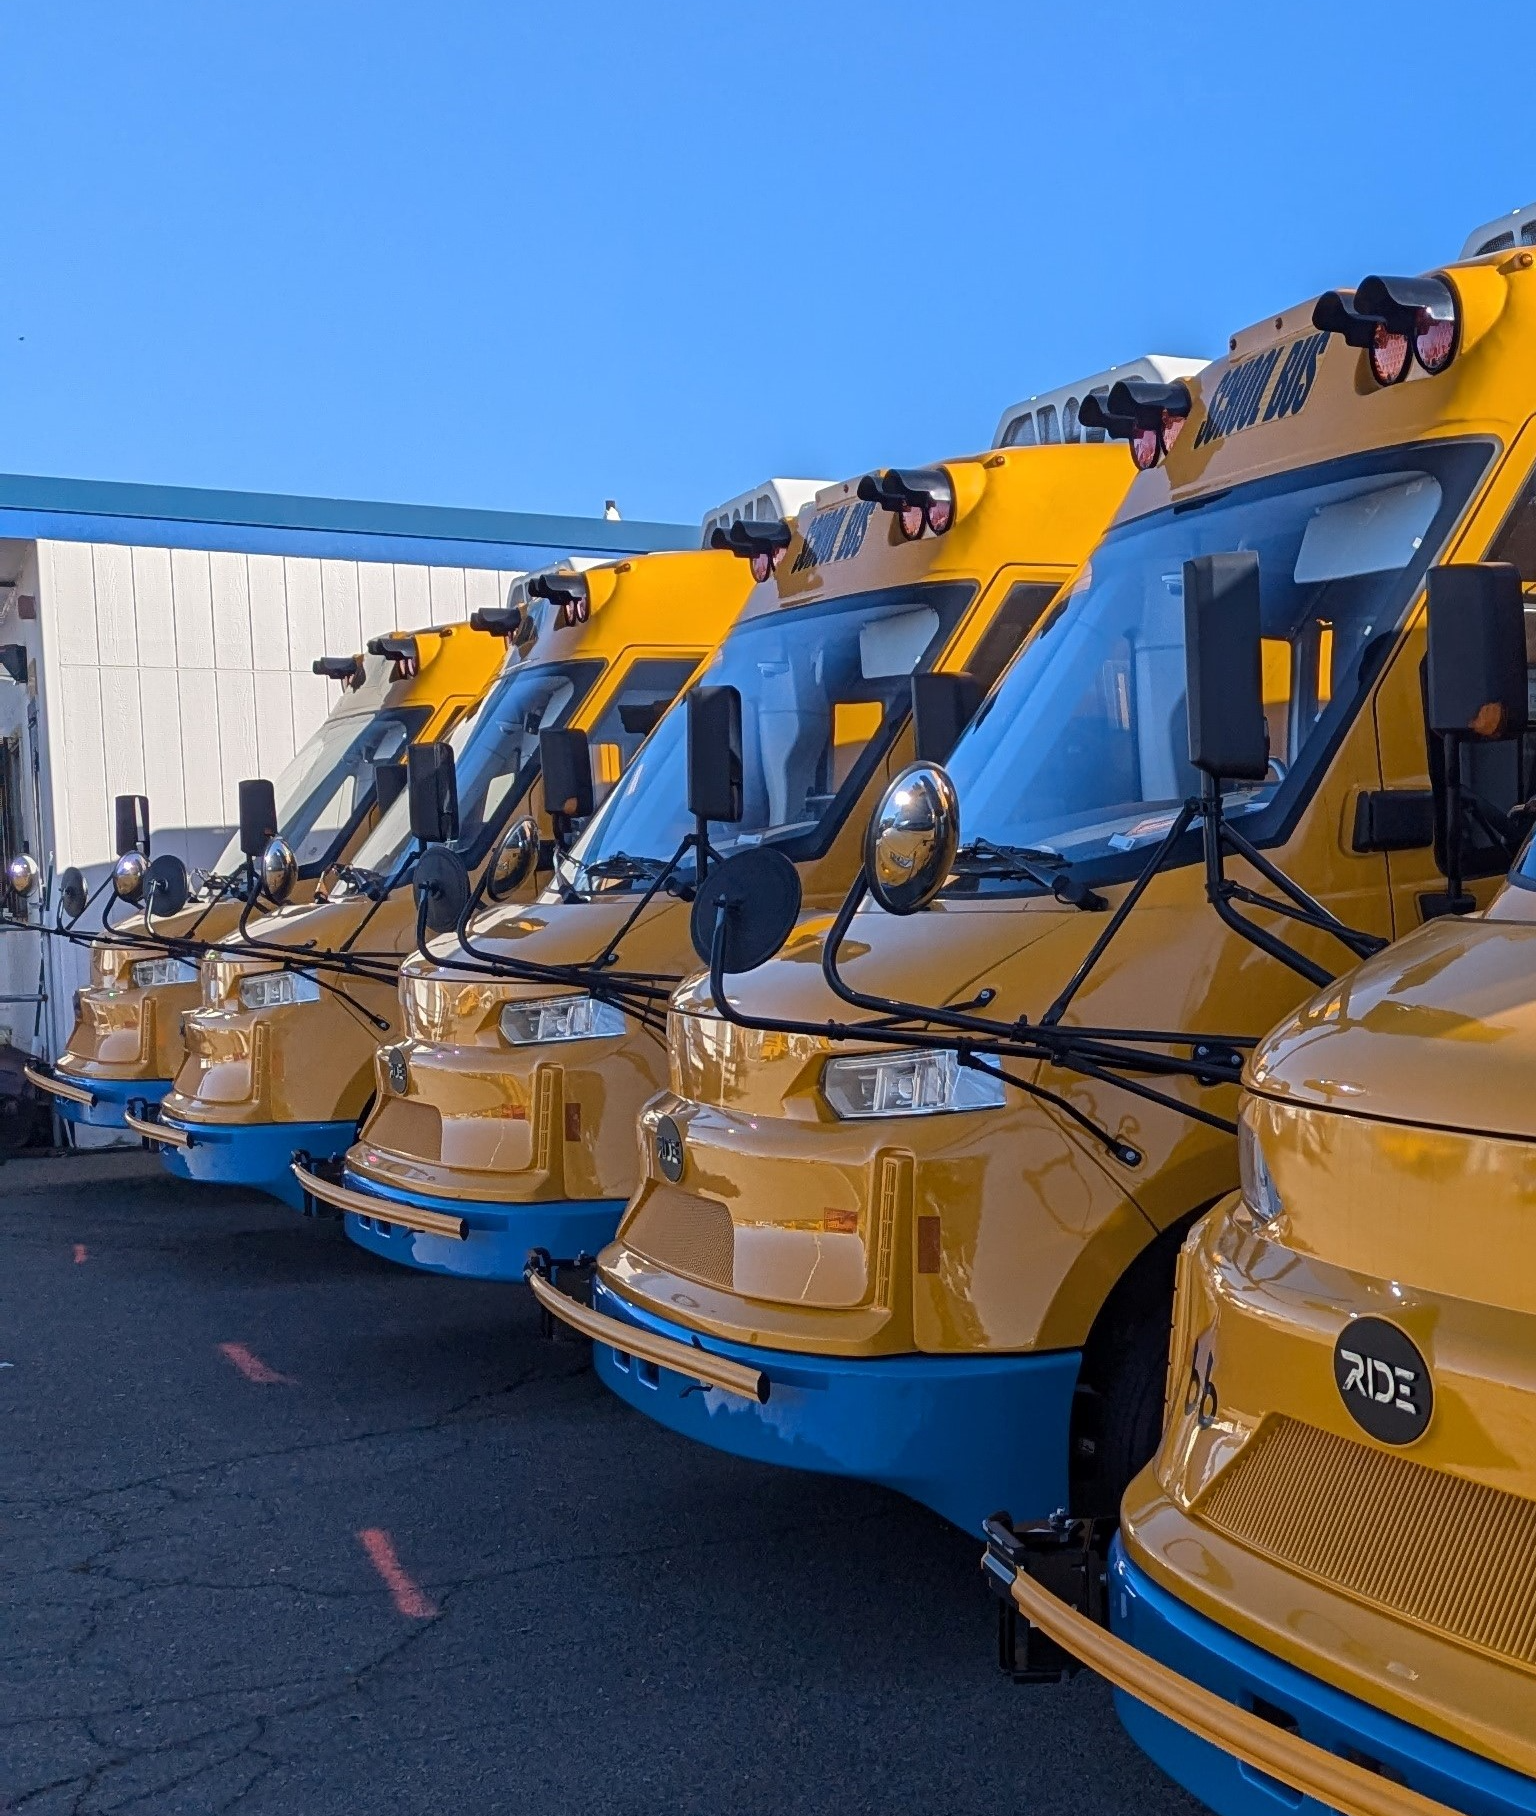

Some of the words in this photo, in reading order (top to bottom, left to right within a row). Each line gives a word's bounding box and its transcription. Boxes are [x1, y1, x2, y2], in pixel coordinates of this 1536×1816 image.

[1194, 345, 1286, 449] SCHOOL
[1262, 331, 1331, 423] BUS
[1340, 1348, 1416, 1415] RIDE
